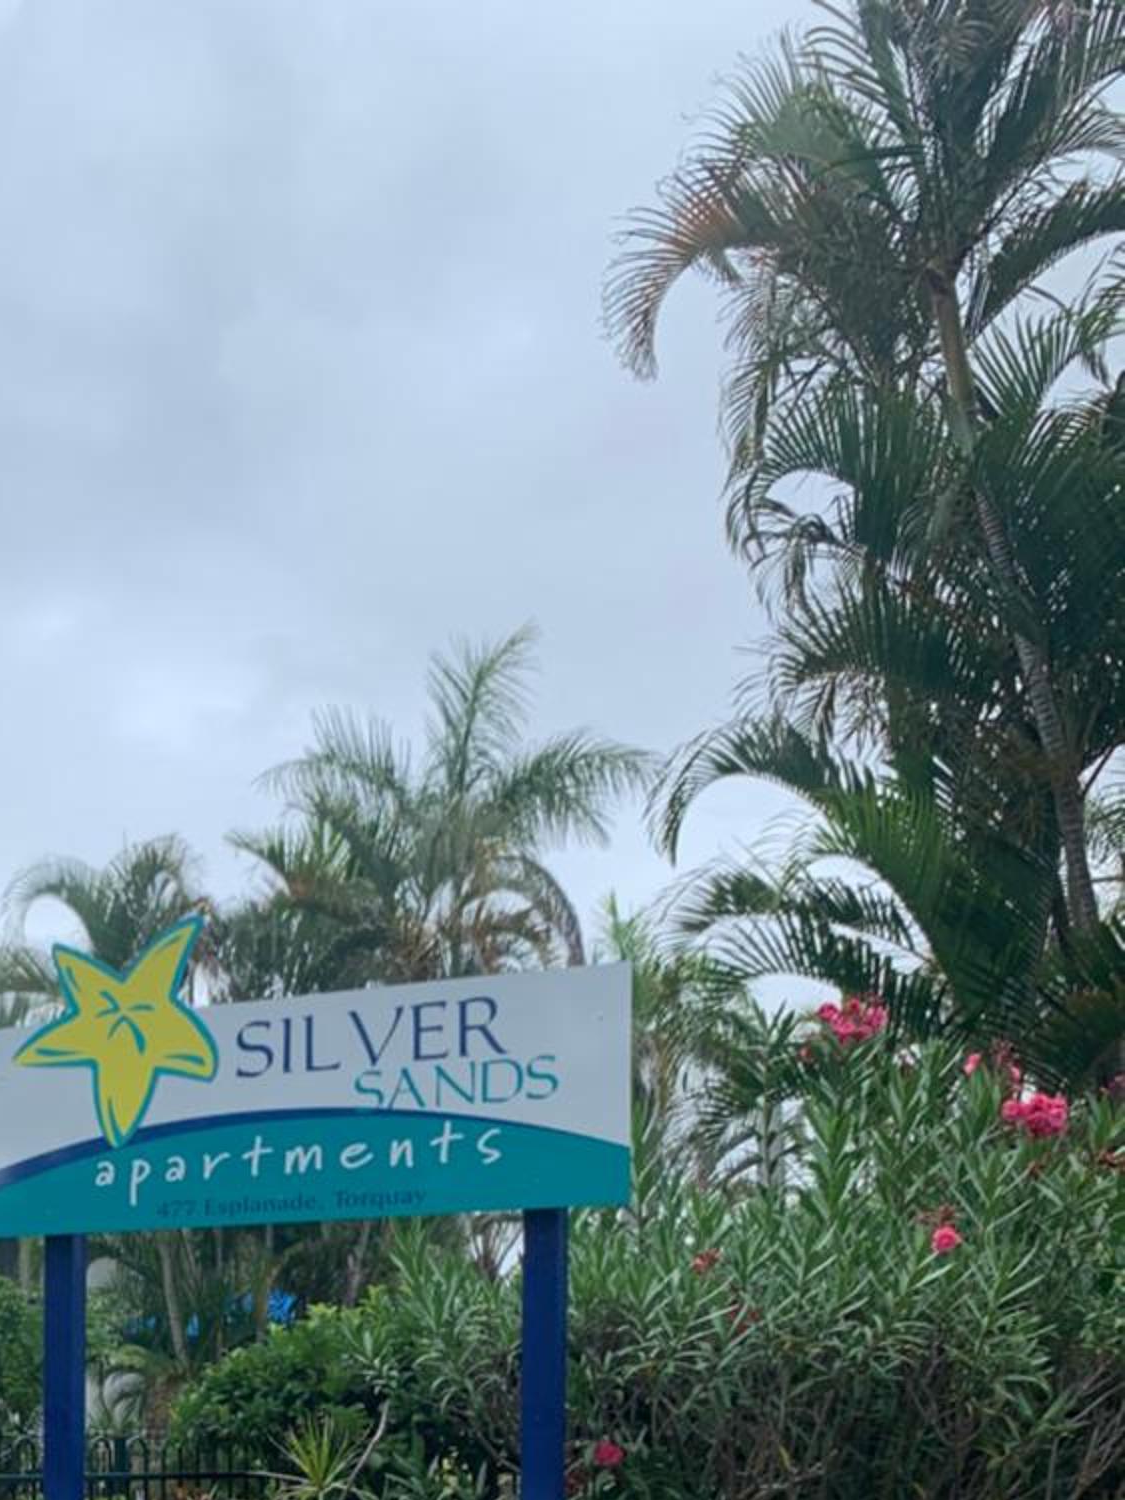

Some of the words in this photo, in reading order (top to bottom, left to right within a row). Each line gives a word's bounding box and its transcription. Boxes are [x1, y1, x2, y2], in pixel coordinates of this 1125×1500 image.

[236, 996, 507, 1078] SILVER
[354, 1055, 559, 1110] SANDS
[95, 1120, 503, 1206] apartments
[156, 1199, 196, 1217] 477
[335, 1187, 426, 1211] Torquay
